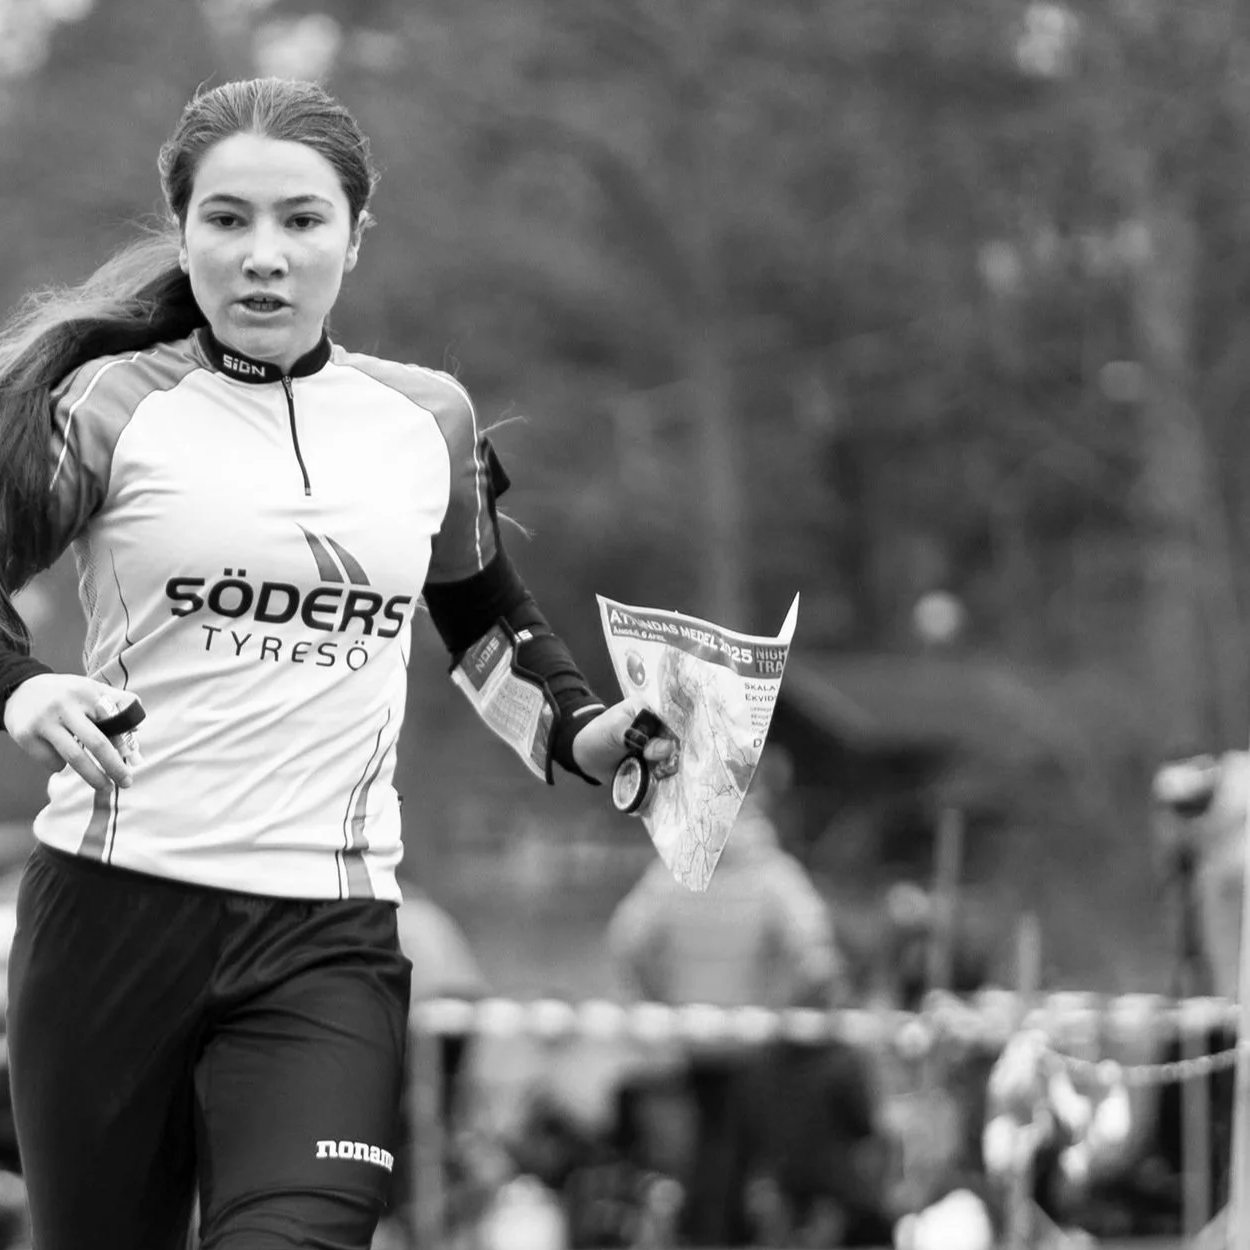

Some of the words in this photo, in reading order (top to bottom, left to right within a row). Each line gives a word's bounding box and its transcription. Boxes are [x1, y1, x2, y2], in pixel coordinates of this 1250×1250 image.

[165, 567, 413, 638] SÖDERS
[202, 624, 368, 671] TYRESÖ
[679, 625, 718, 651] MEDEL
[718, 638, 753, 664] 2025
